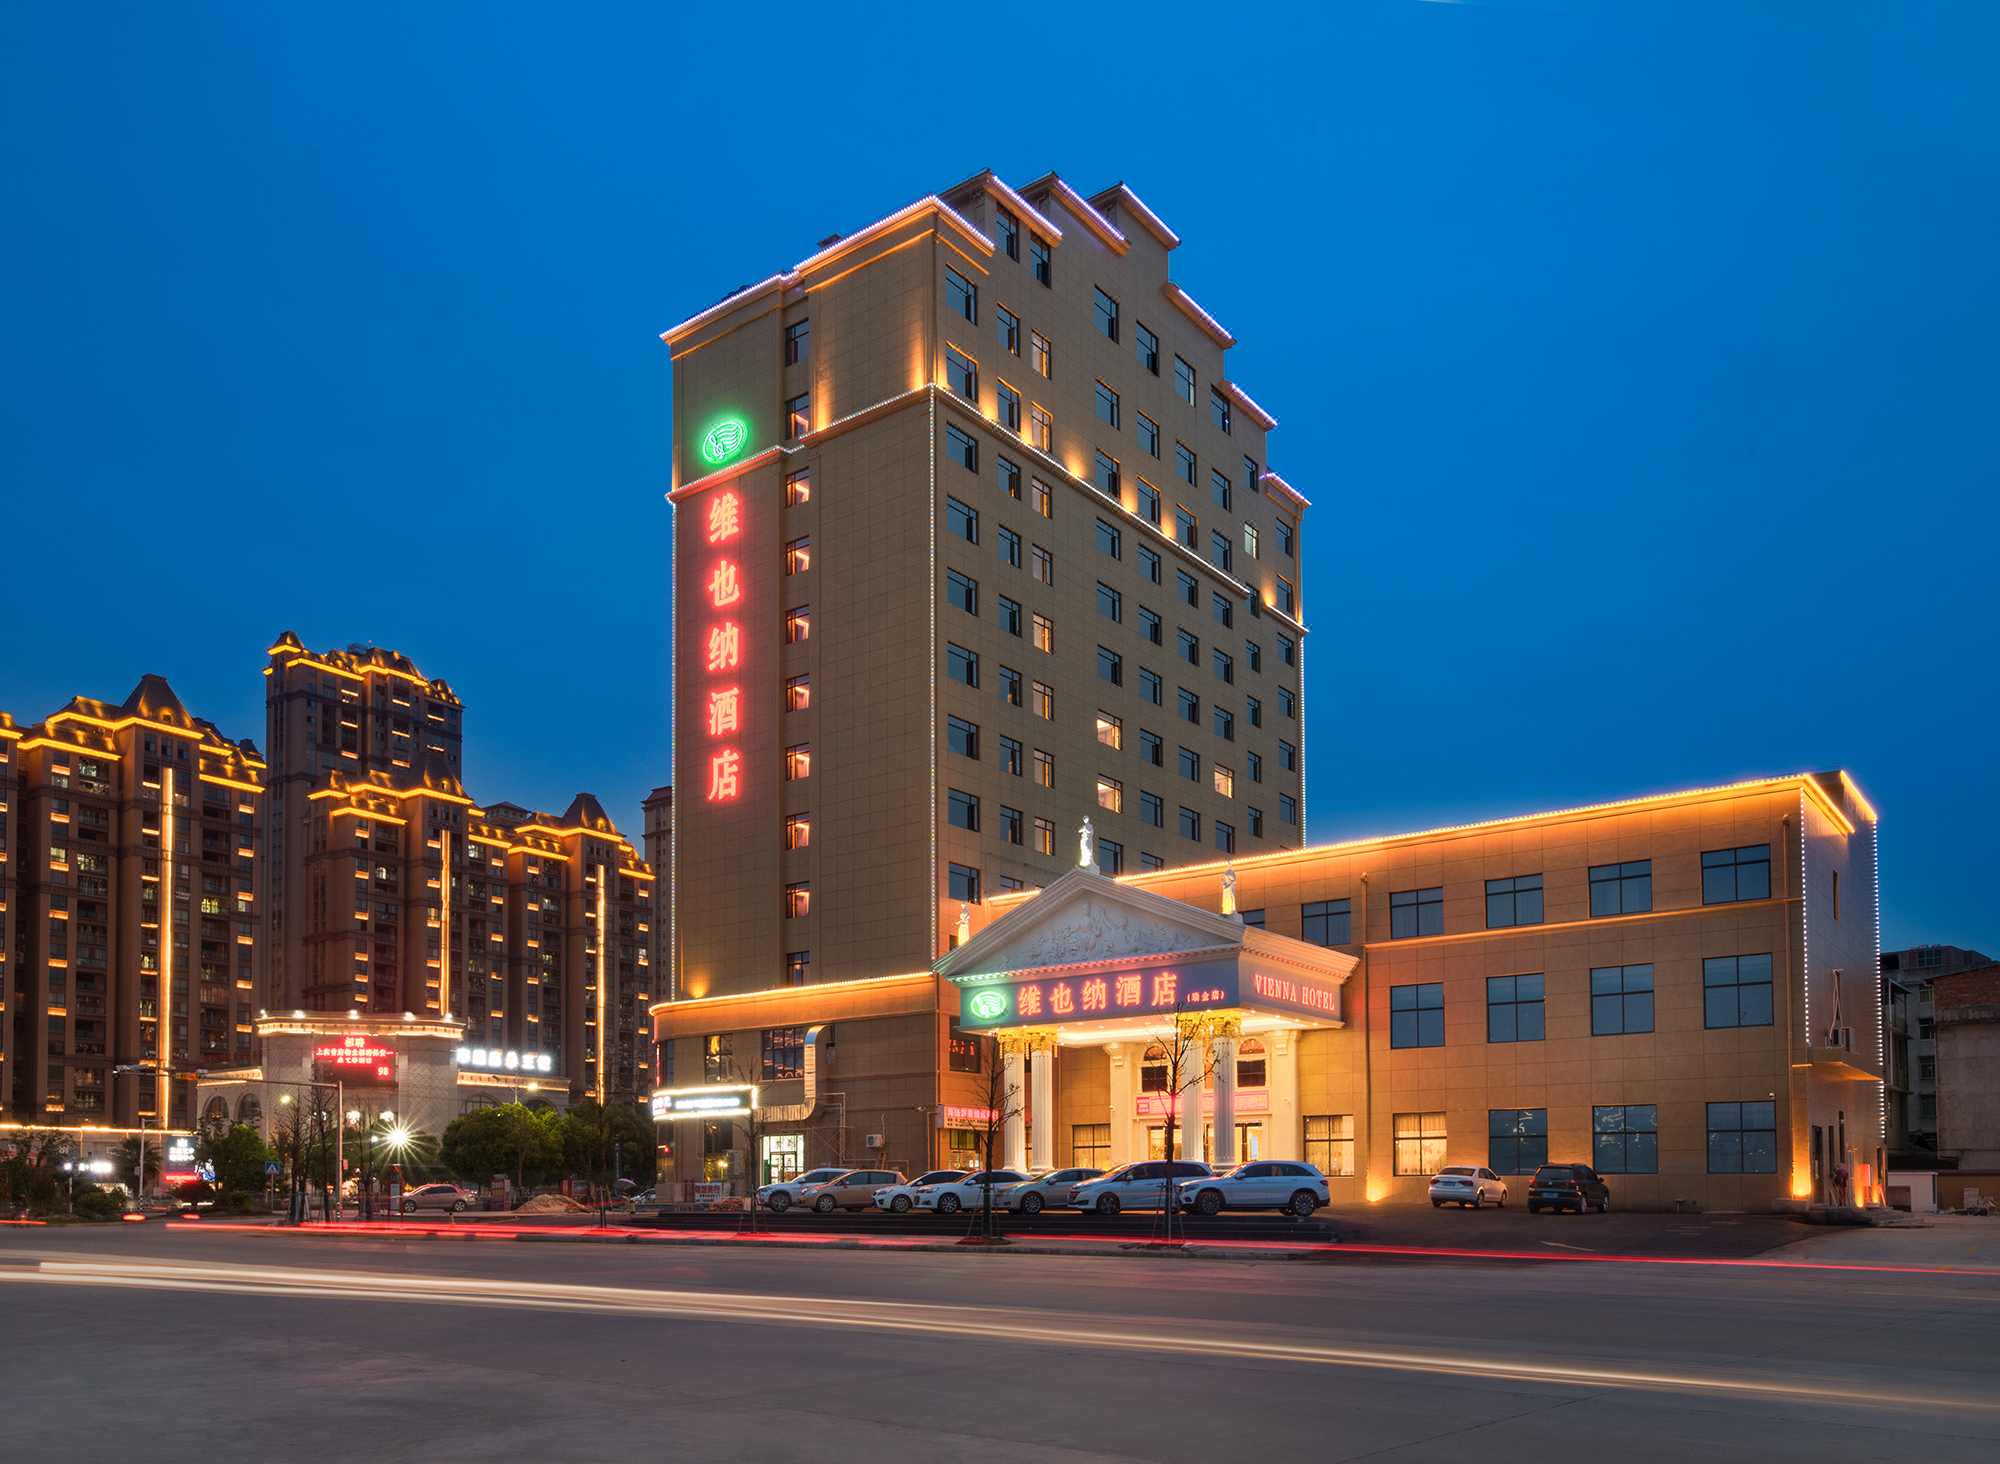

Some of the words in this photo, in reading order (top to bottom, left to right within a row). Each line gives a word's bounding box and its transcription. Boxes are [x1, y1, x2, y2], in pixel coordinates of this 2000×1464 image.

[708, 492, 740, 801] 维也纳酒店
[1018, 972, 1178, 1017] 维也纳酒店
[1254, 974, 1297, 1003] VIENNA
[1301, 985, 1335, 1011] HOTEL
[377, 1066, 389, 1076] 98
